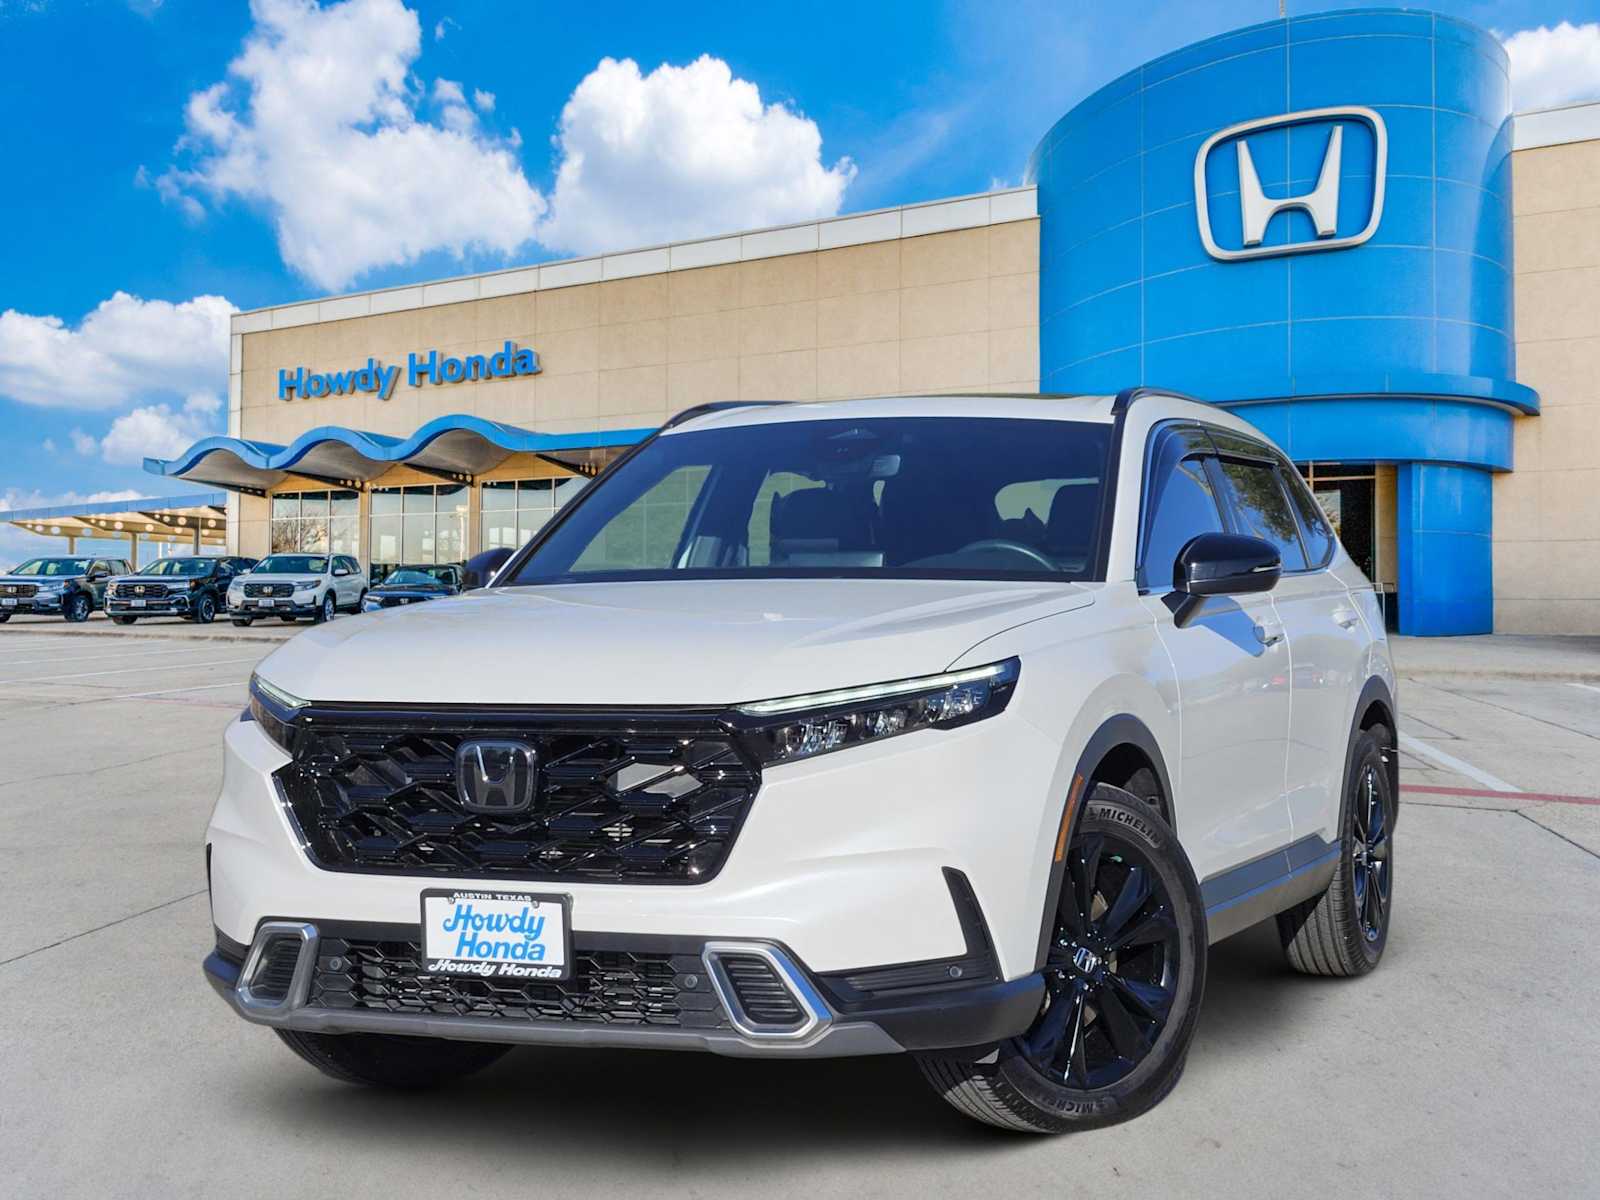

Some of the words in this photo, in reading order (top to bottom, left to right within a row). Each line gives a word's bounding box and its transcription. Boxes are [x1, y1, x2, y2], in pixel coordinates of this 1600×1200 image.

[279, 358, 402, 400] Howdy
[408, 341, 542, 387] Honda
[453, 892, 492, 900] AUSTIN
[495, 894, 532, 902] TEXAS
[443, 904, 546, 941] Howdy
[455, 932, 546, 961] Honda
[428, 959, 497, 976] Howdy
[498, 963, 562, 978] Honda
